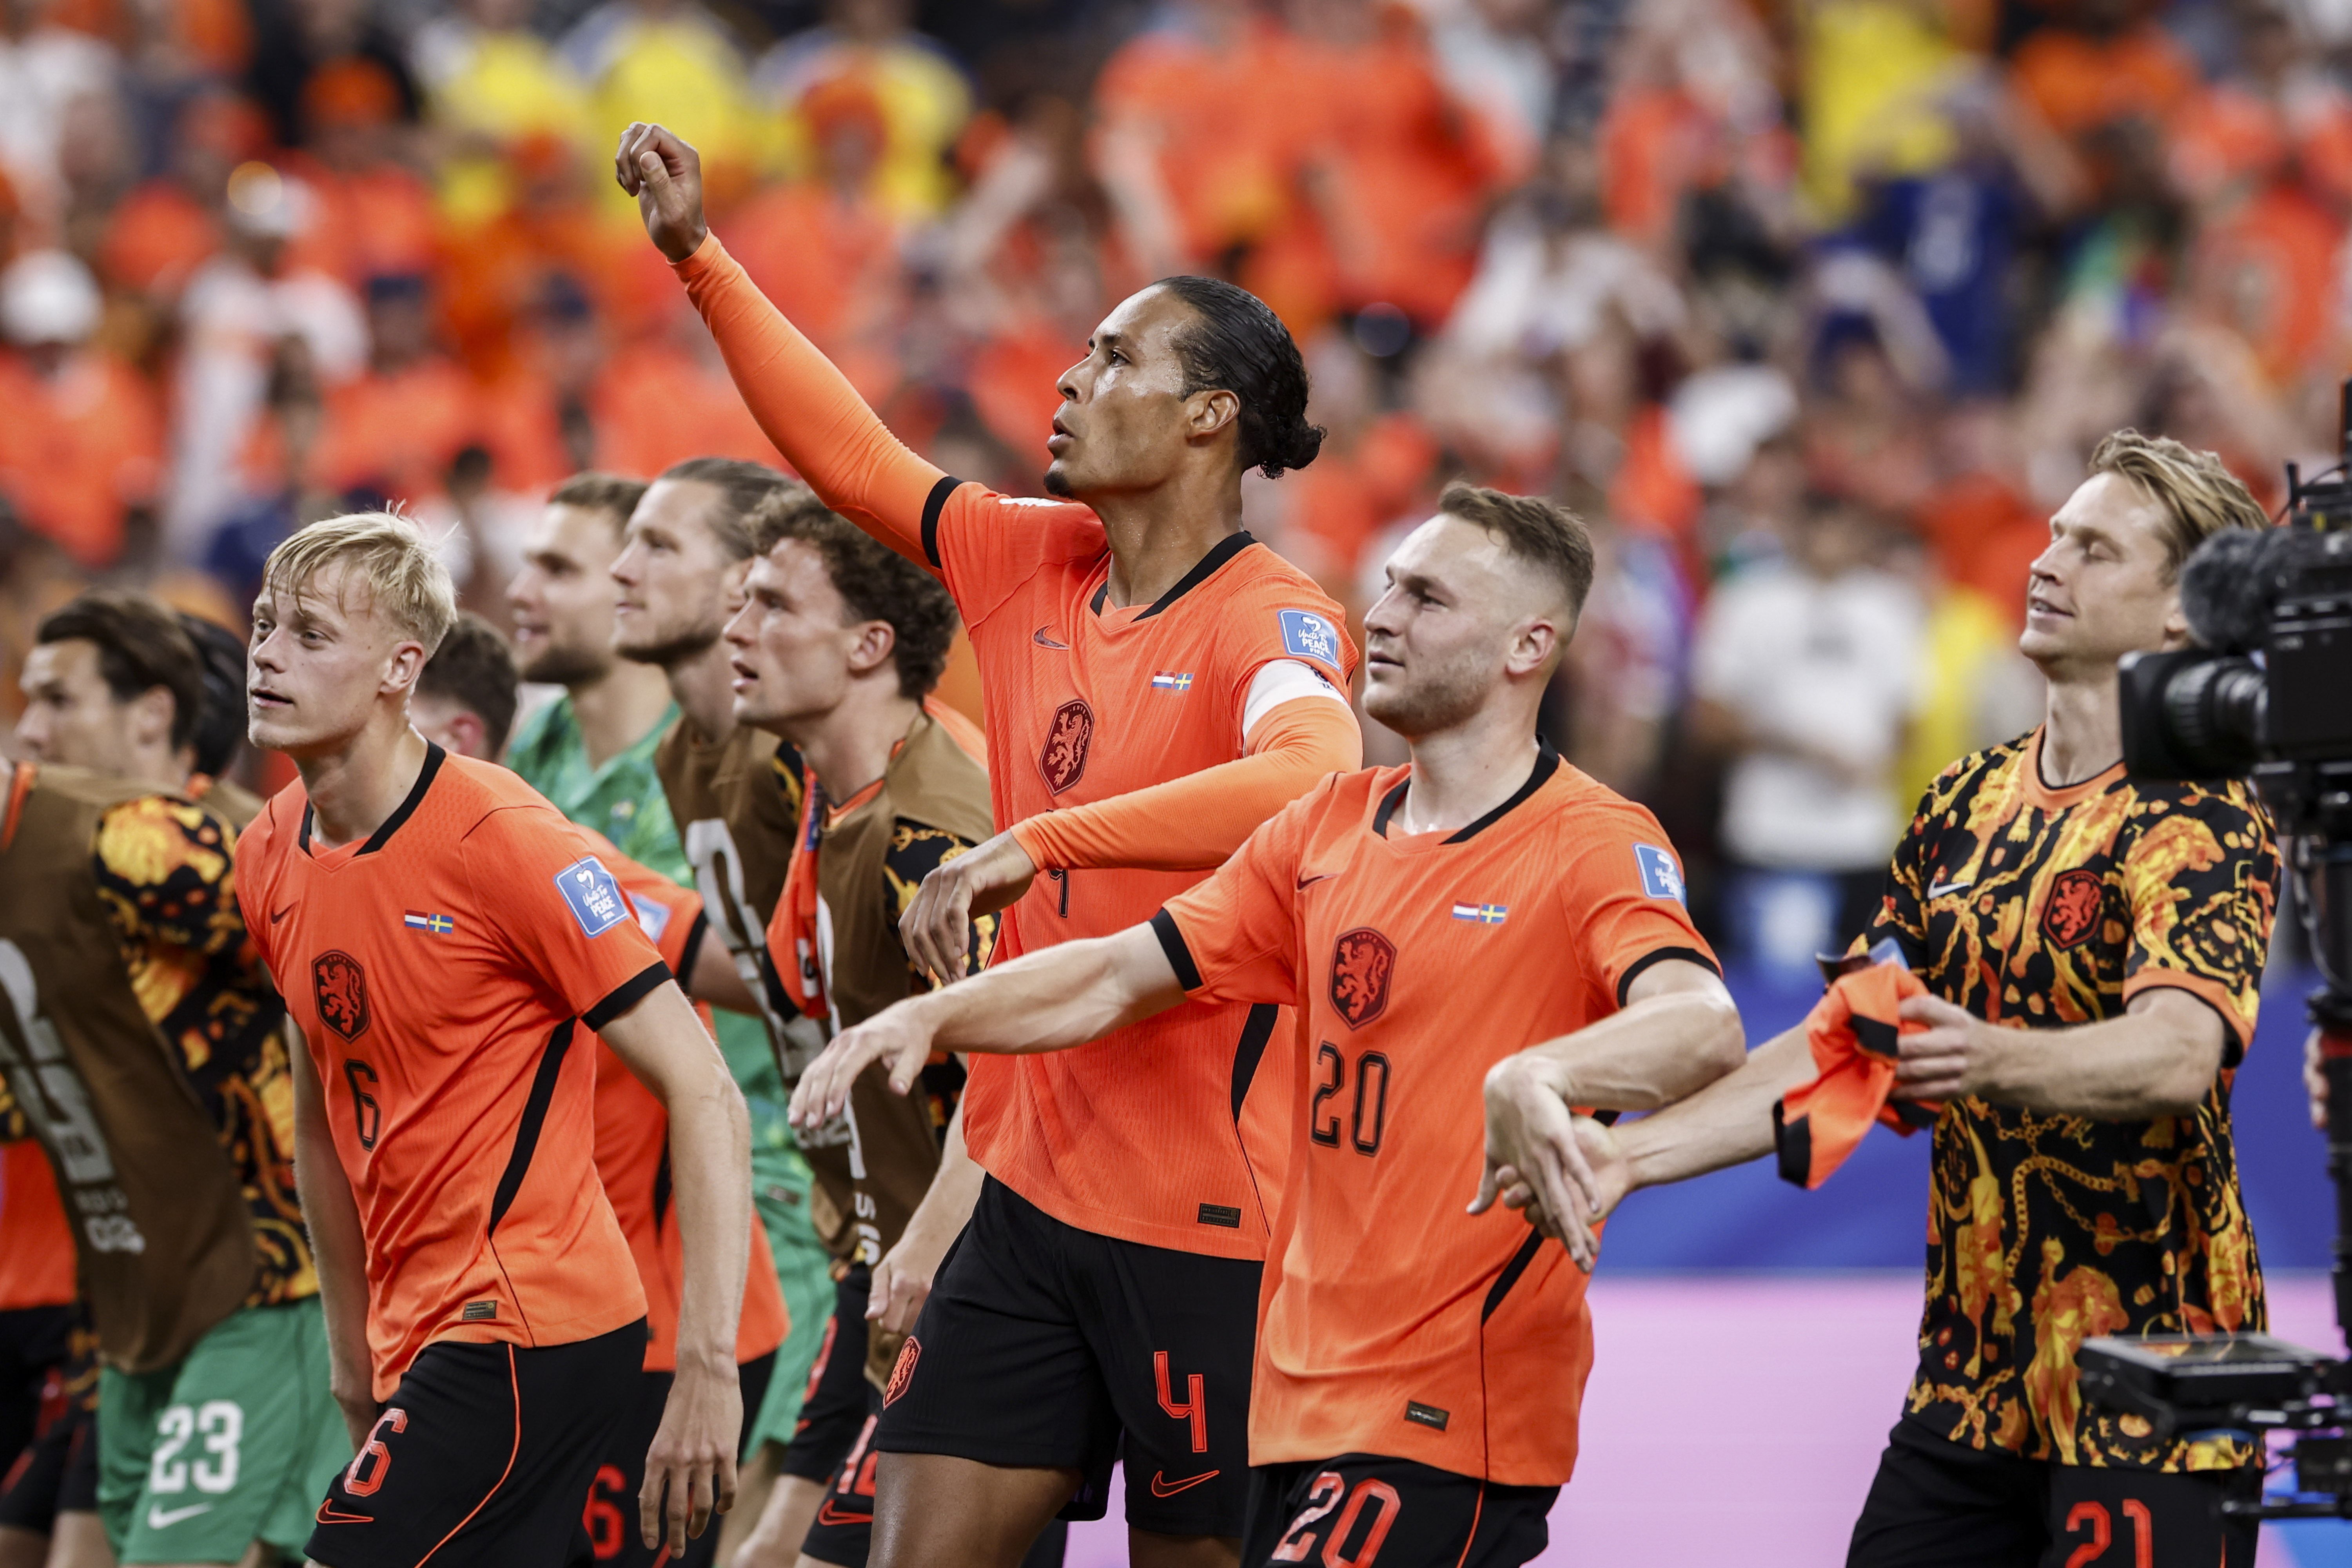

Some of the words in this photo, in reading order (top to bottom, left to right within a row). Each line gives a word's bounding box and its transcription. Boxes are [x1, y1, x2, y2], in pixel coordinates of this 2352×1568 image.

[1302, 638, 1330, 654] PEACE
[590, 895, 615, 917] PEACE
[343, 1059, 380, 1151] 6
[1310, 1041, 1391, 1157] 20
[150, 1399, 244, 1494] 23
[1154, 1351, 1207, 1452] 4
[343, 1408, 408, 1497] 6
[1271, 1471, 1401, 1568] 20
[2065, 1499, 2153, 1568] 21
